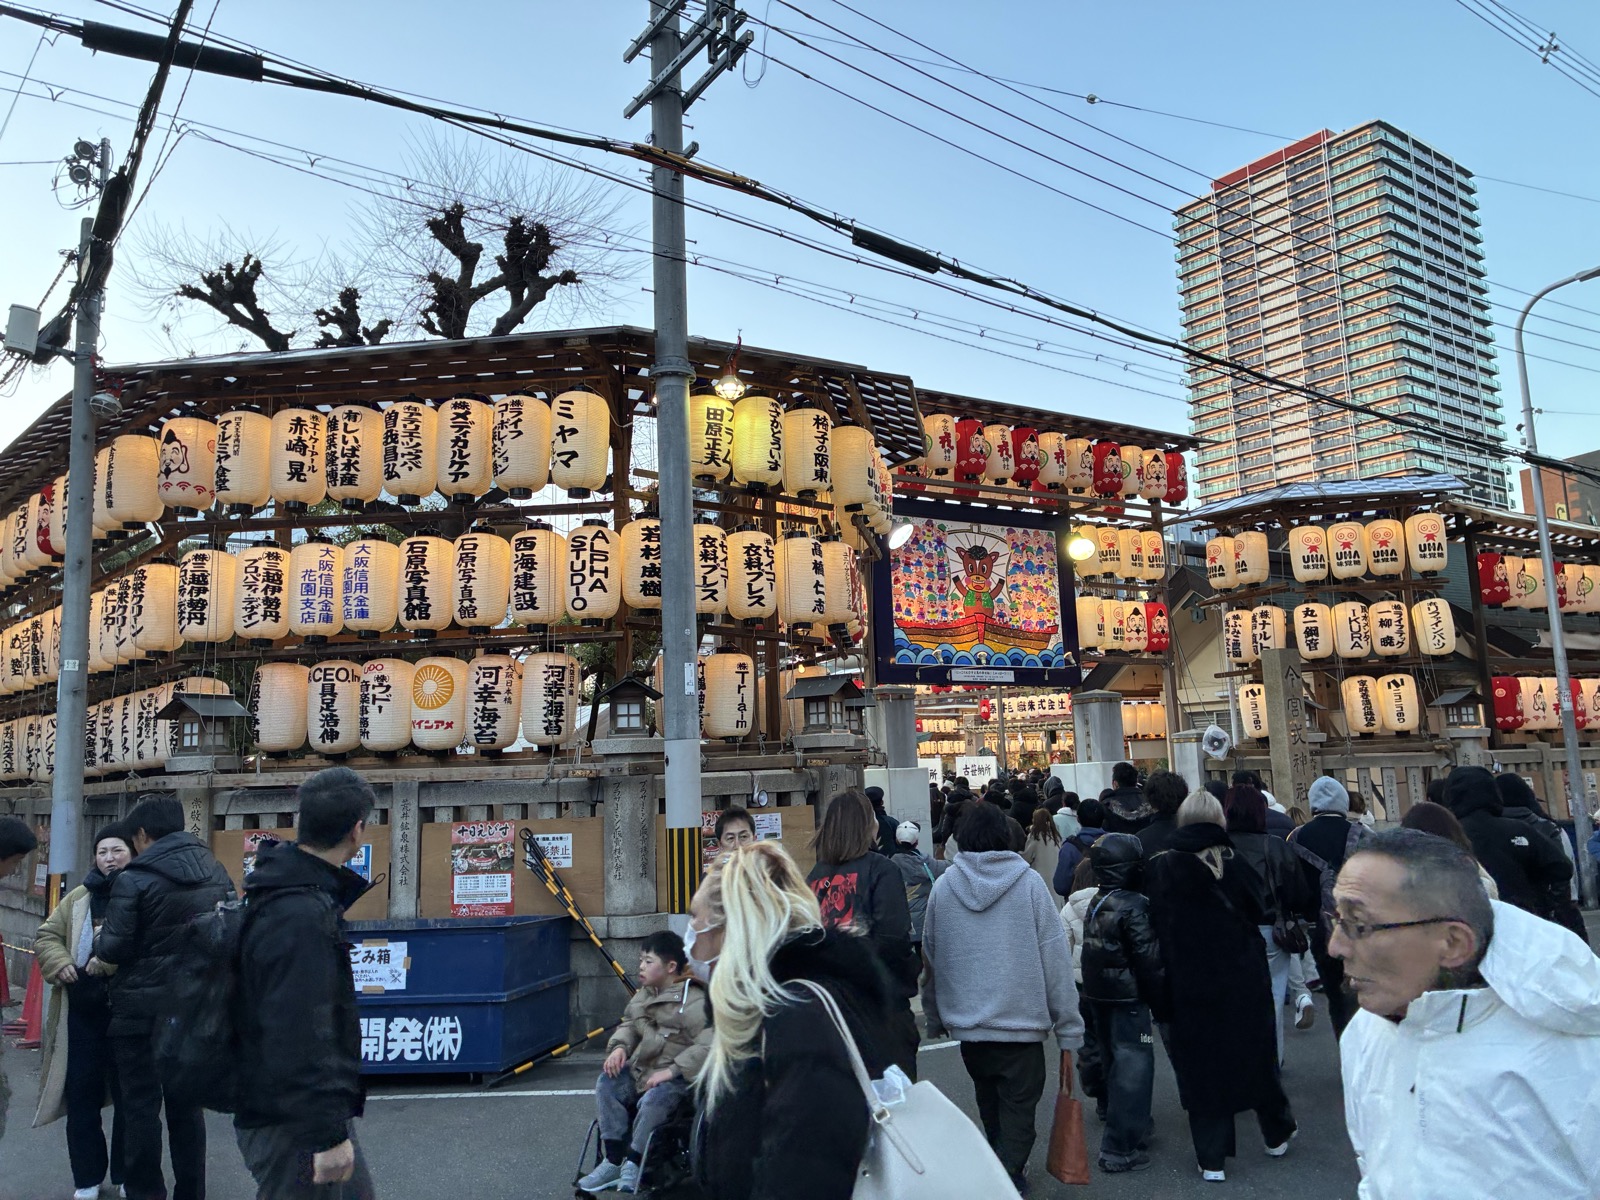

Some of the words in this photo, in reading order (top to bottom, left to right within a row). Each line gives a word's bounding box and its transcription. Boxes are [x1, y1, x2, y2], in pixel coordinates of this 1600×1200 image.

[556, 399, 579, 469] ミヤマ
[704, 406, 724, 467] 田原正夫
[353, 544, 371, 619] 大阪信用金庫
[403, 540, 432, 621] 石原写真館
[456, 536, 479, 620] 石原写真館
[513, 536, 540, 611] 西海建設
[570, 535, 588, 611] STUDIO
[588, 529, 610, 593] ALPHA
[699, 534, 721, 602] 衣料プレス
[743, 543, 766, 608] 衣料プレス
[1302, 553, 1326, 564] UHA
[1335, 550, 1361, 561] UHA
[1372, 548, 1398, 559] UHA
[1418, 542, 1444, 553] UHA
[186, 553, 210, 626] (株)三越伊勢丹
[260, 551, 285, 624] (株)三越伊勢丹
[300, 569, 317, 624] 花園支店
[317, 547, 335, 625] 大阪信用金庫
[1301, 607, 1320, 652] 丸一鋼管
[1348, 609, 1364, 650] IKURA
[473, 665, 503, 745] 河幸海苔
[1285, 665, 1309, 801] 今宮戎神社
